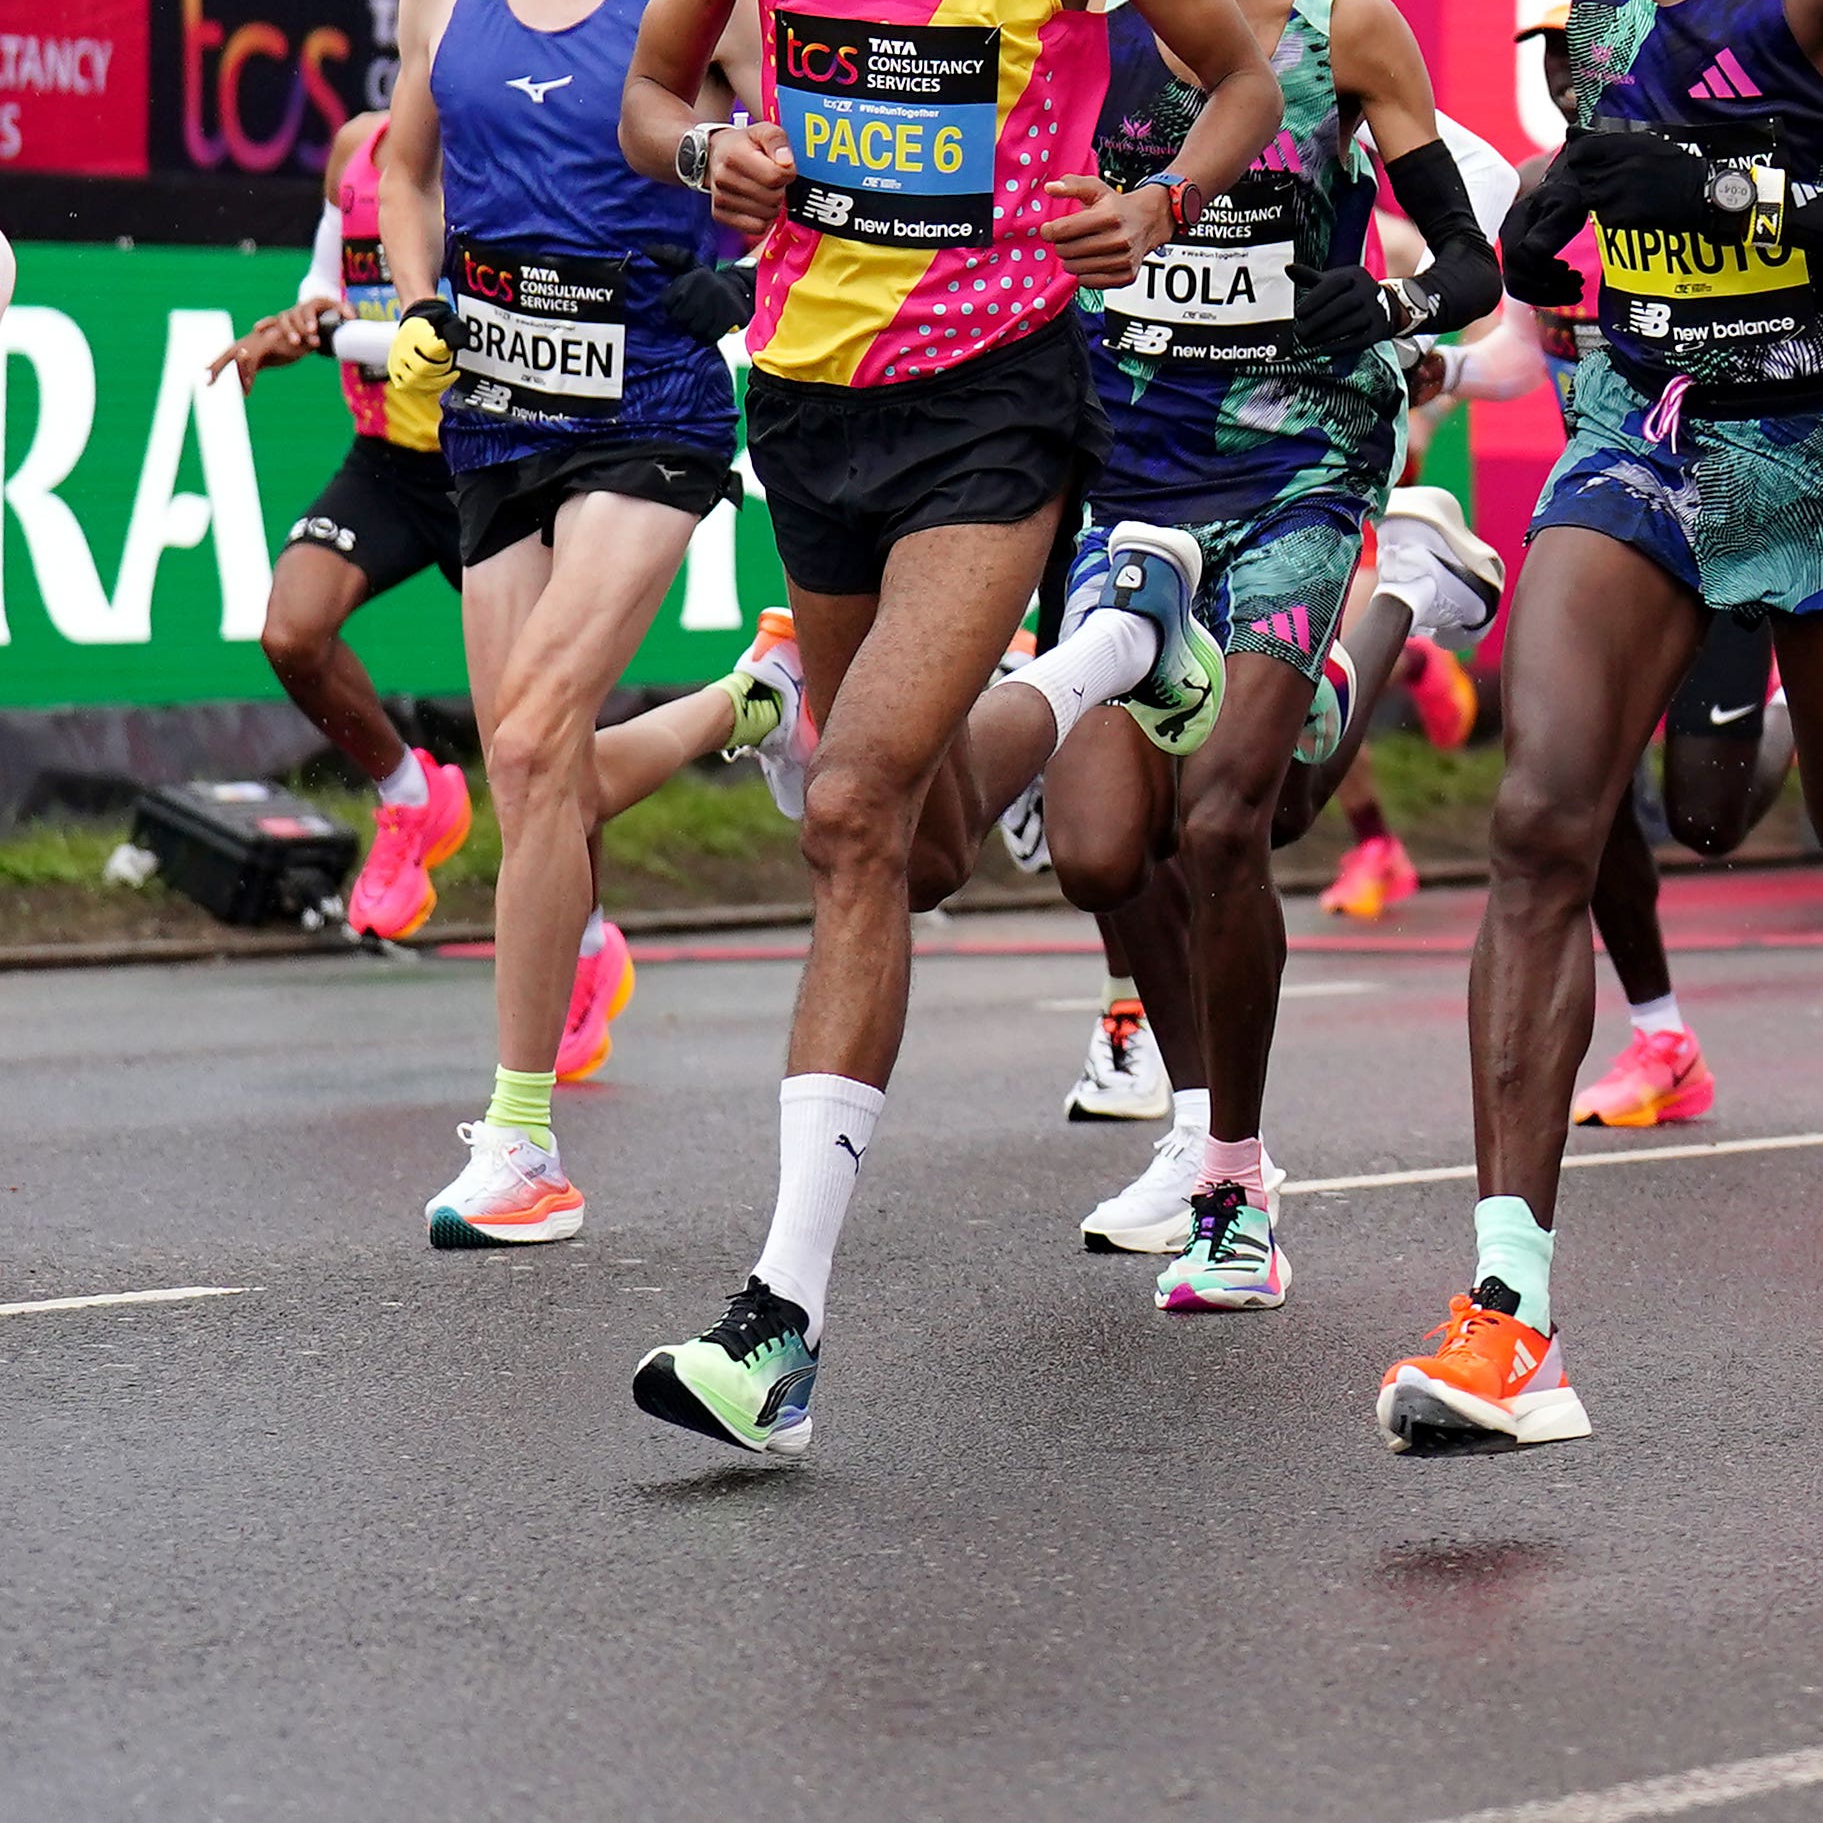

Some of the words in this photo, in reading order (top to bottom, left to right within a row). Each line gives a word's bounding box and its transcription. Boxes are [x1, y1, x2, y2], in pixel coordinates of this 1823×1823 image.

[786, 27, 859, 86] tcs
[868, 37, 917, 56] TATA
[868, 55, 984, 75] CONSULTANCY
[867, 74, 941, 93] SERVICES
[804, 112, 924, 173] PACE
[934, 124, 964, 175] 6
[854, 216, 891, 234] new
[894, 212, 972, 238] balance
[1200, 205, 1283, 224] ONSULTANCY
[1188, 222, 1252, 239] SERVICES
[464, 251, 514, 302] tcs
[520, 266, 560, 283] TATA
[1142, 260, 1257, 306] TOLA
[519, 281, 614, 302] CONSULTANCY
[519, 294, 579, 312] SERVICES
[1673, 326, 1709, 342] new
[1712, 316, 1796, 339] balance
[466, 315, 614, 379] BRADEN
[1173, 344, 1207, 359] new
[1210, 343, 1277, 361] balance
